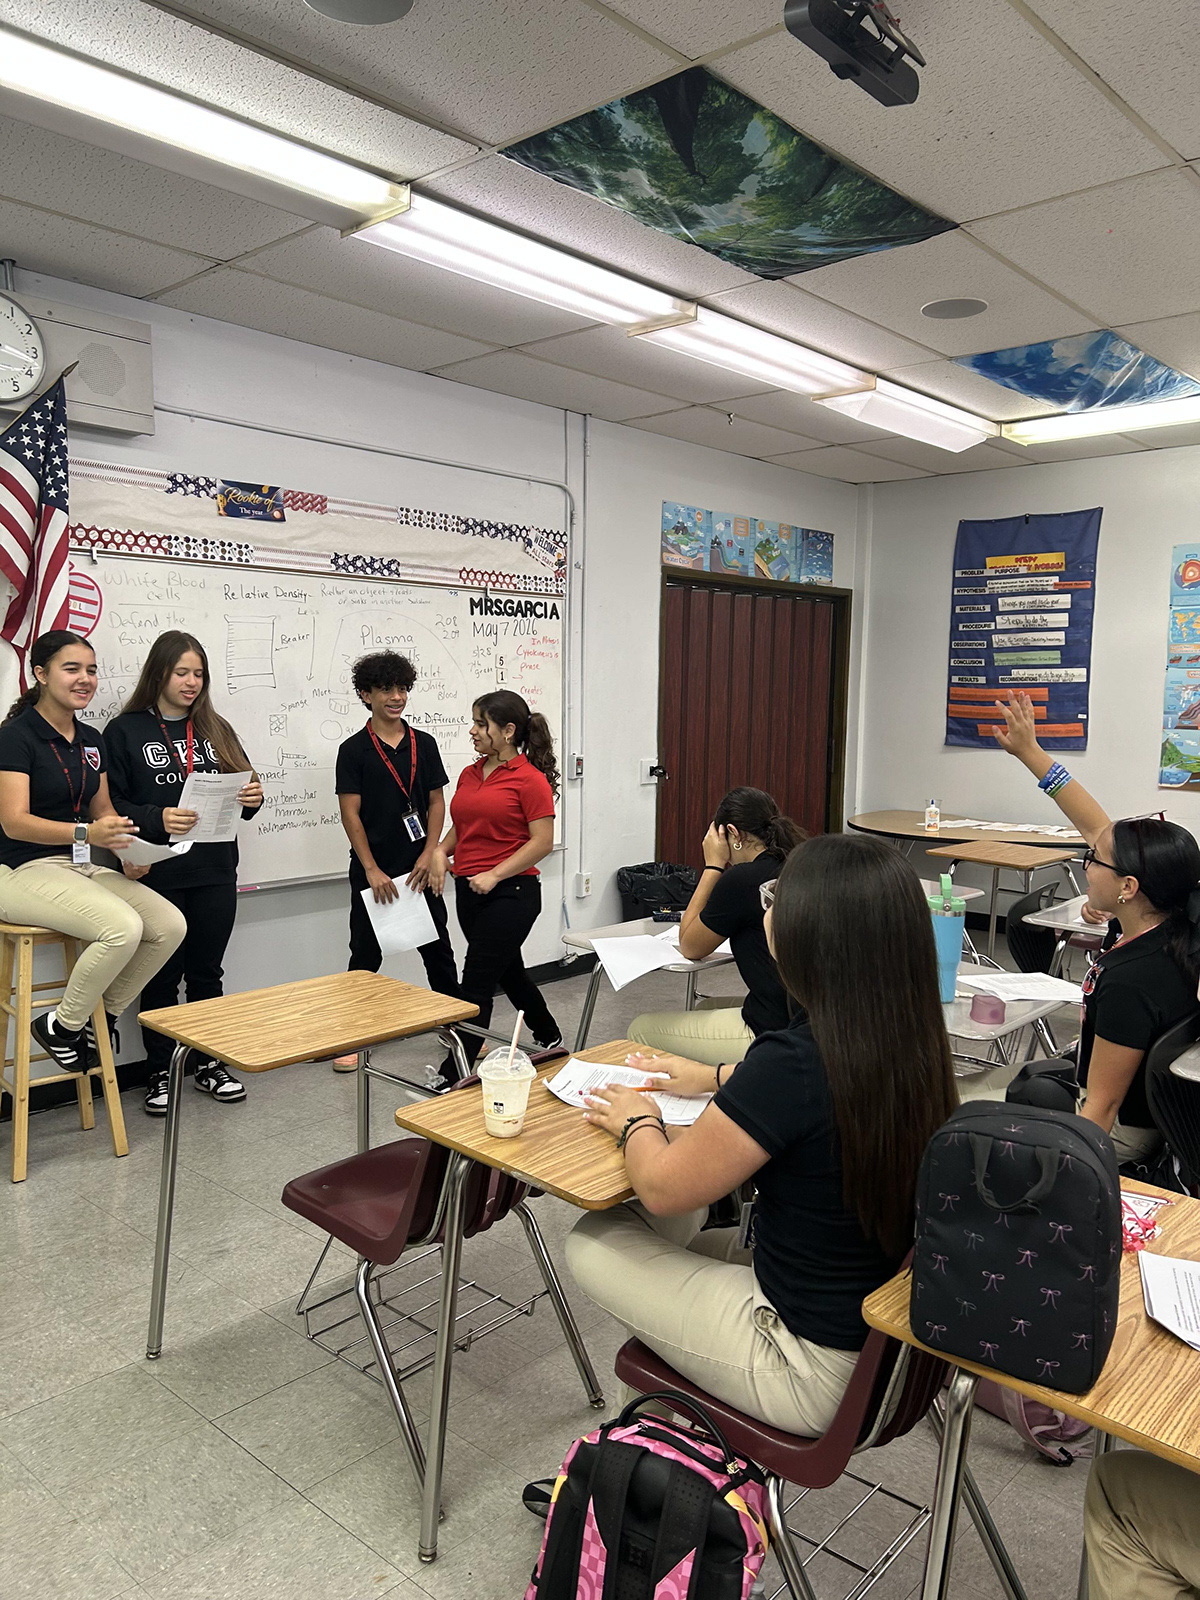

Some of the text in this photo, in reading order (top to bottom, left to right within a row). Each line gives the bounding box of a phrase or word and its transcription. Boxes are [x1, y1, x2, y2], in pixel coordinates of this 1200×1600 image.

[11, 307, 14, 318] 1
[25, 323, 33, 336] 2
[31, 346, 38, 359] 3
[25, 365, 34, 378] 4
[12, 381, 20, 393] 5
[225, 487, 277, 512] Rookie of
[239, 507, 251, 515] The
[678, 556, 691, 566] Cycle
[167, 570, 206, 589] Blood
[223, 583, 270, 601] Relative
[166, 610, 187, 627] the
[118, 631, 152, 647] Body
[280, 633, 310, 645] Beaker
[360, 624, 414, 647] Plasma
[472, 619, 538, 647] May 7 2026
[498, 655, 505, 667] 5
[500, 671, 505, 681] 1
[404, 713, 423, 725] The
